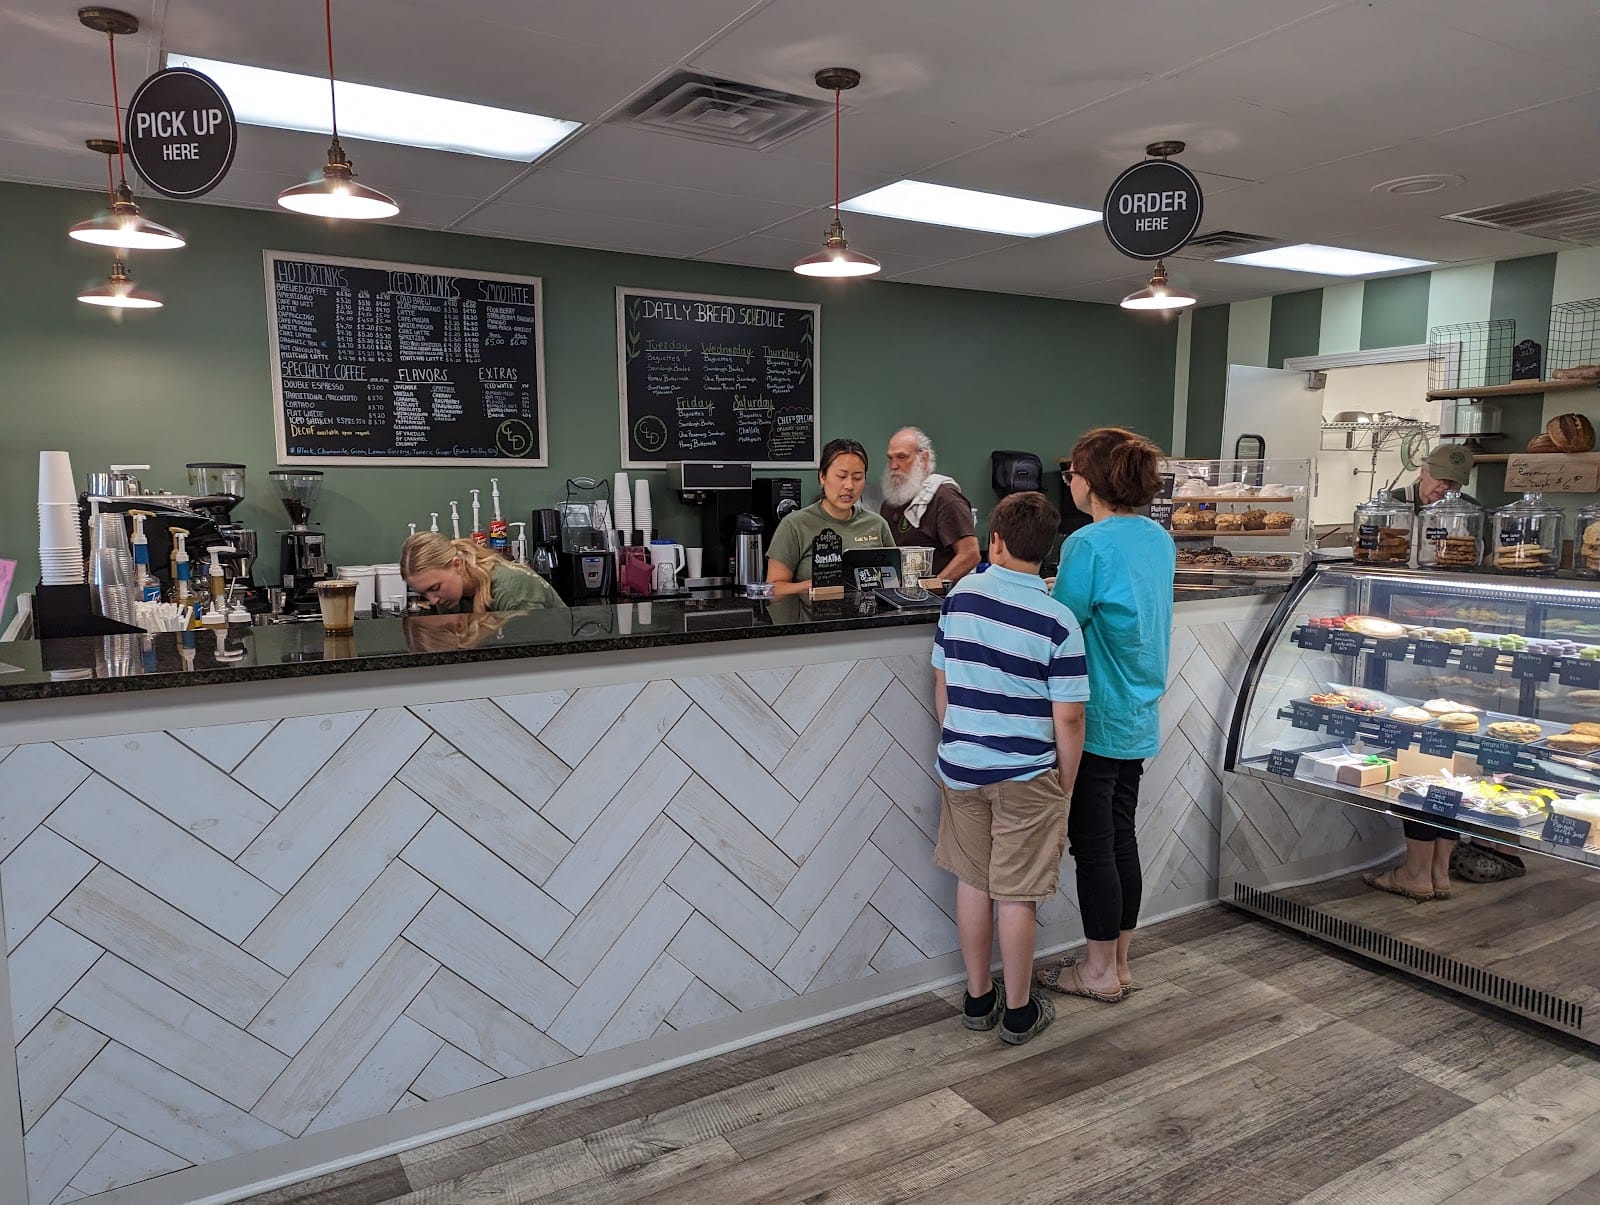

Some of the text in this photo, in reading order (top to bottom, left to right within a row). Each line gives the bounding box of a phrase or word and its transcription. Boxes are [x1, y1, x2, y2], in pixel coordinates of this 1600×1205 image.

[136, 108, 223, 139] PICK UP
[162, 143, 200, 161] HERE
[1118, 190, 1188, 215] ORDER
[1135, 217, 1169, 232] HERE
[277, 260, 349, 288] HOT DRINKS
[276, 283, 304, 293] BREWED
[304, 285, 328, 296] COFFEE
[388, 271, 461, 299] ICED DRINKS
[478, 280, 529, 305] SMOOTHIE
[412, 297, 431, 305] BREW
[642, 299, 785, 328] DAILY BREAD SCHEDULE
[645, 339, 688, 358] Tuesday
[647, 352, 681, 364] Baguettes
[700, 341, 754, 366] Wednesday
[761, 345, 801, 368] Thursday
[281, 361, 367, 380] SPECIALTY COFFEE
[398, 368, 449, 382] FLAVORS
[478, 367, 518, 381] EXTRAS
[283, 379, 345, 392] DOUBLE ESPRESSO
[284, 400, 316, 409] CORTADO
[286, 409, 302, 418] FLAT
[676, 395, 714, 417] Friday
[732, 393, 775, 419] Saturday
[814, 552, 843, 564] SUMATRA
